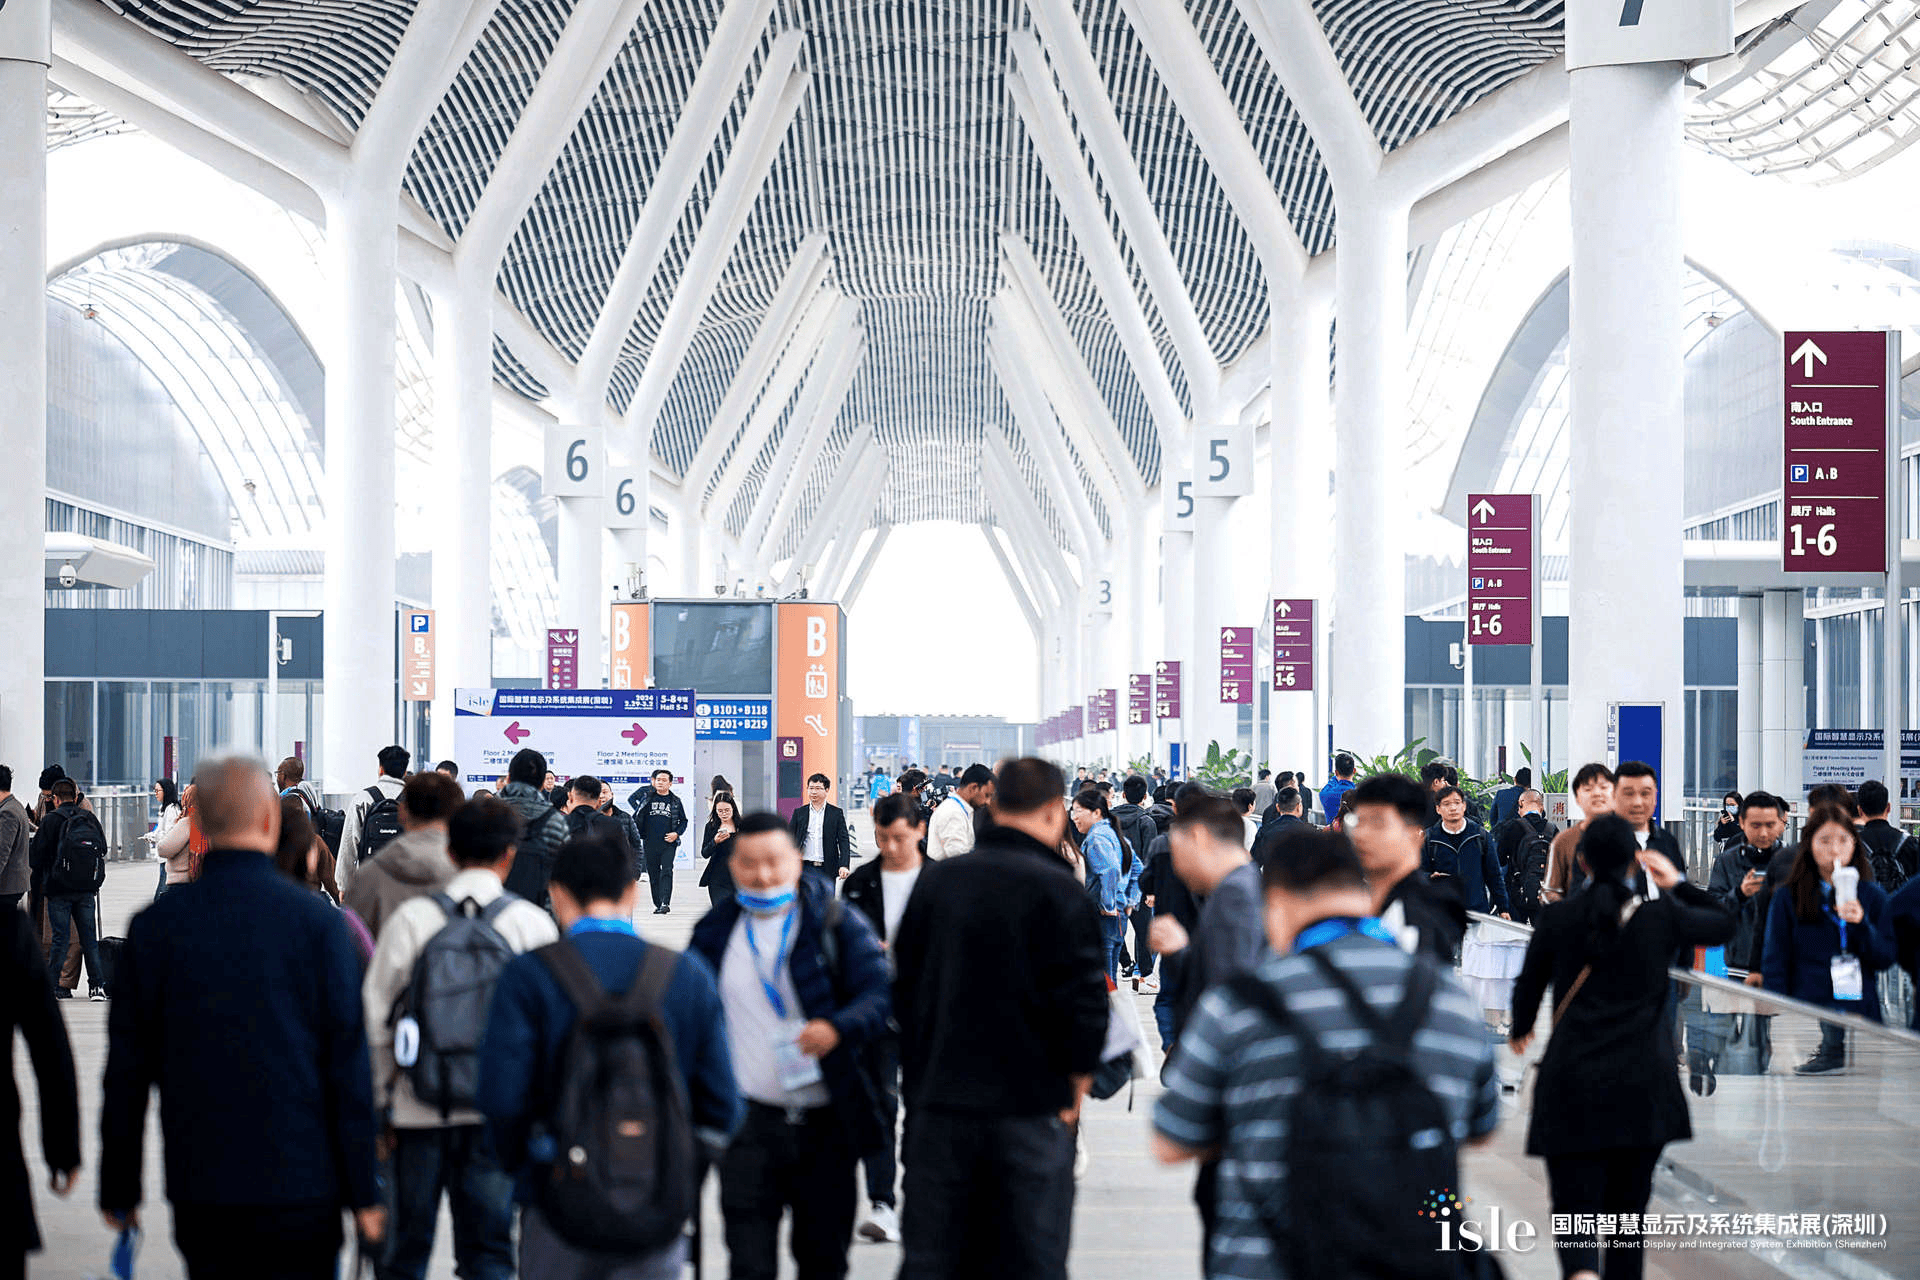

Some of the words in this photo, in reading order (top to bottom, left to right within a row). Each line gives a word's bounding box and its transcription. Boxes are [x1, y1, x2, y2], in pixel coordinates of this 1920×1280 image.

[1790, 401, 1823, 413] 南入口
[1790, 416, 1816, 426] South
[1816, 416, 1854, 426] Entrance
[566, 439, 588, 482] 6
[1208, 439, 1230, 482] 5
[1794, 467, 1805, 480] P
[616, 479, 635, 516] 6
[1176, 481, 1194, 518] 5
[1790, 505, 1812, 517] 展厅
[1815, 505, 1836, 516] Halls
[1790, 523, 1838, 557] 1-6
[1099, 579, 1111, 604] 3
[1474, 579, 1482, 588] P
[1488, 603, 1502, 611] Halls
[414, 616, 426, 631] P
[614, 610, 631, 652] B
[1472, 614, 1503, 636] 1-6
[414, 636, 425, 655] B
[807, 616, 827, 658] B
[1275, 671, 1296, 687] 1-6
